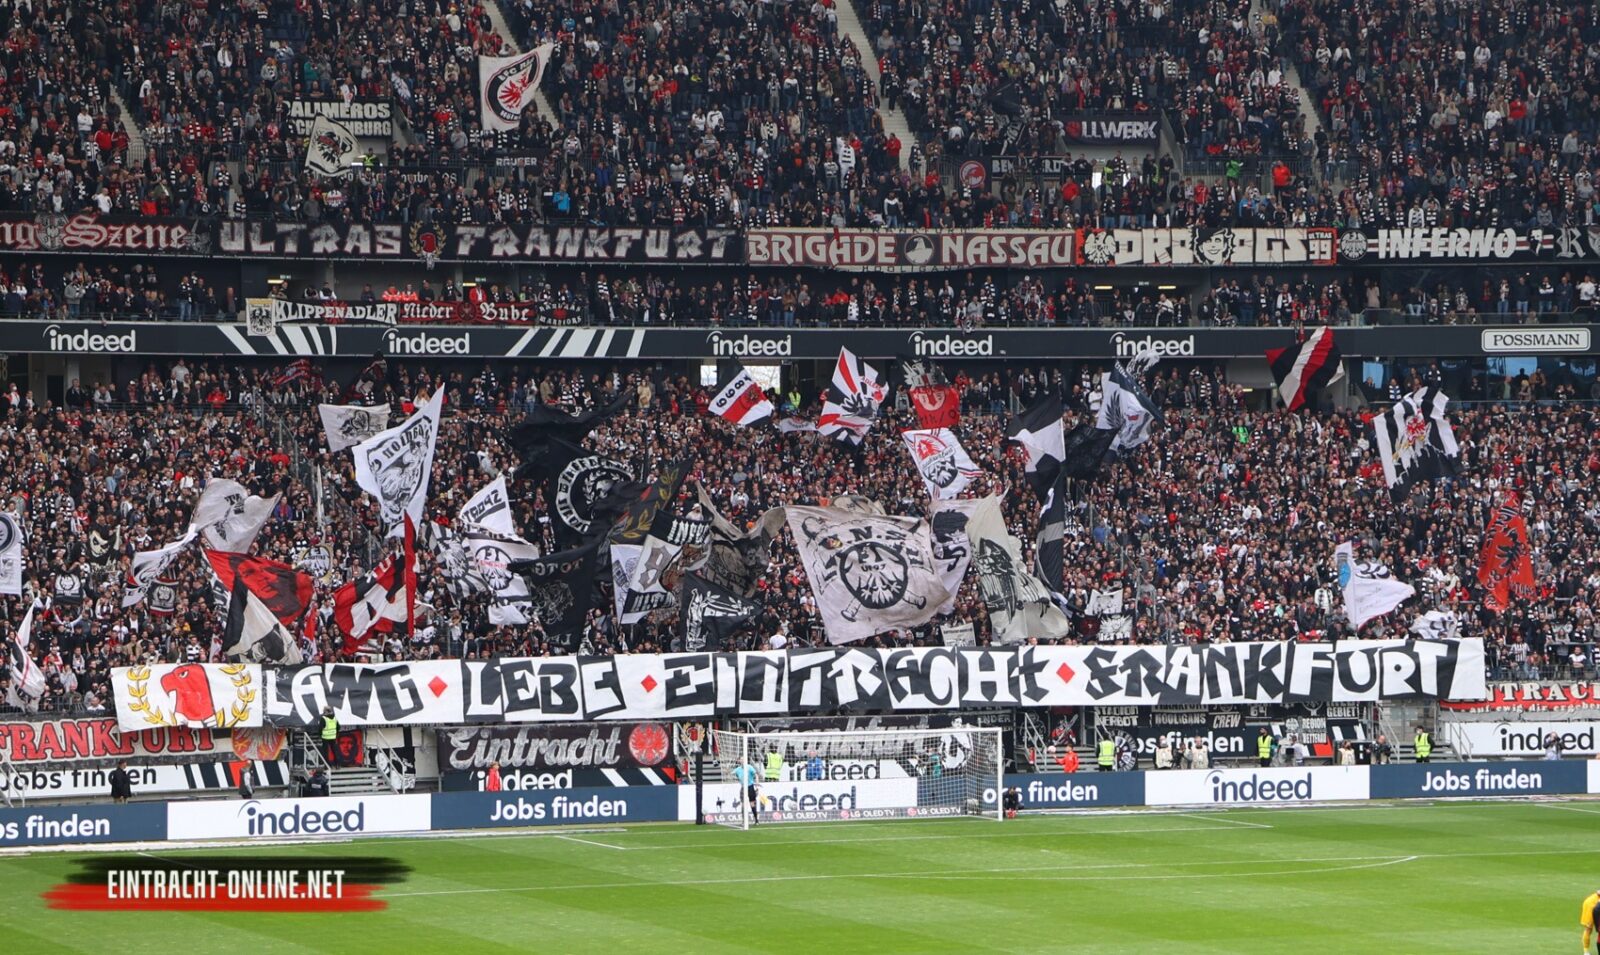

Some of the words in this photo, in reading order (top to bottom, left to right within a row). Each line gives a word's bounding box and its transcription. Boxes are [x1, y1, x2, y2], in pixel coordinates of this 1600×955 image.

[63, 214, 188, 249] Szene
[220, 221, 401, 254] ULTRAS
[455, 226, 736, 259] FRANKFURT
[748, 234, 896, 267] BRIGADE
[941, 235, 1073, 266] NASSAU
[1308, 240, 1329, 260] 99
[1378, 228, 1518, 259] INFERNO
[275, 301, 397, 324] KLIPPENADLER
[49, 329, 136, 352] indeed
[388, 332, 470, 354] indeed
[712, 335, 792, 356] indeed
[914, 335, 993, 356] indeed
[1115, 335, 1195, 356] indeed
[1493, 334, 1580, 346] POSSMANN
[265, 664, 424, 726] LANG
[465, 659, 627, 717] LEBE
[664, 645, 1050, 711] EINTRACHT
[1083, 641, 1451, 700] FRANKFURT
[1155, 713, 1207, 725] HOOLIGANS
[1213, 714, 1241, 729] CREW
[1302, 717, 1326, 729] REGION
[1327, 706, 1355, 718] GEBIET
[448, 726, 622, 770] Eintracht
[72, 766, 157, 788] finen
[477, 769, 573, 792] ideed
[1212, 772, 1312, 801] indeed
[1421, 770, 1471, 792] Jobs
[1475, 768, 1542, 790] finden
[1028, 780, 1098, 802] finden
[246, 801, 365, 835] indeed
[490, 799, 546, 822] Jobs
[551, 796, 627, 819] finden
[714, 815, 726, 823] LG
[782, 813, 794, 821] LG
[796, 812, 815, 821] OLED
[816, 811, 829, 820] TV
[849, 810, 861, 818] LG
[863, 808, 883, 818] OLED
[883, 808, 895, 817] TV
[916, 808, 928, 817] LG
[929, 806, 949, 816] OLED
[949, 806, 961, 815] TV
[25, 813, 110, 839] finden
